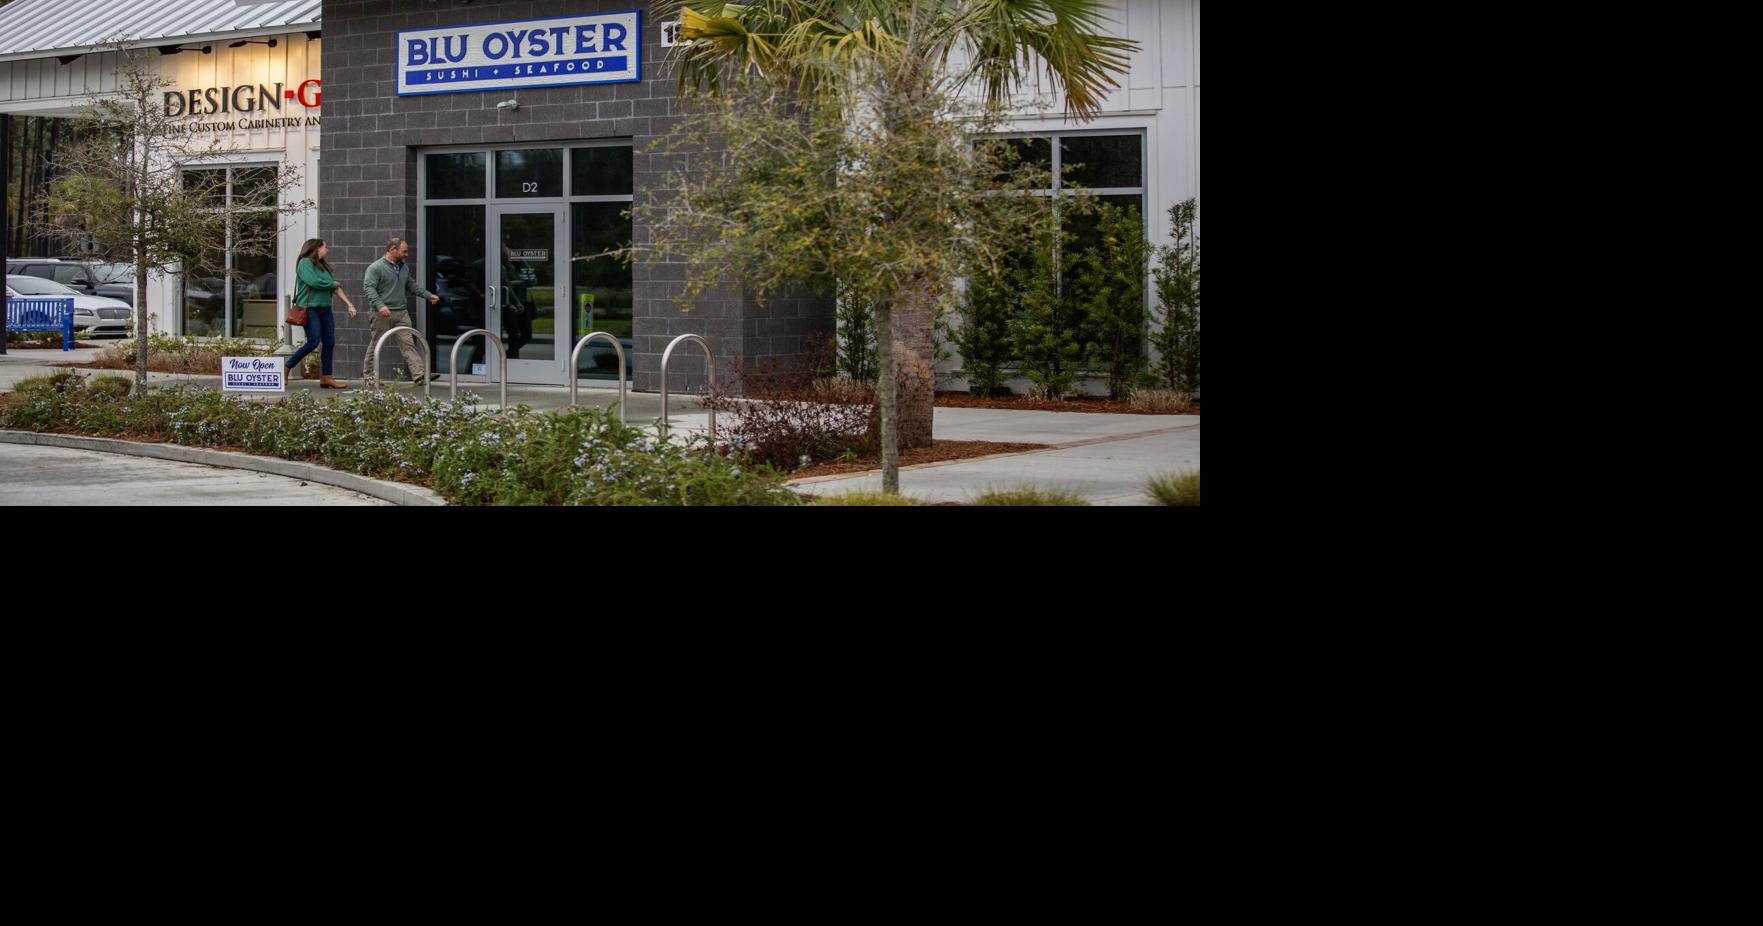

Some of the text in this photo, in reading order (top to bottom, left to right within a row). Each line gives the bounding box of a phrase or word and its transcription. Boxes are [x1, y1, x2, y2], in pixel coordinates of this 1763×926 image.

[406, 22, 627, 66] BLU OYSTER
[426, 69, 478, 81] SUSHI
[514, 61, 604, 75] SEAFOOD
[189, 121, 235, 133] CUSTOM
[238, 117, 301, 130] CABINETRY
[522, 182, 538, 193] D2
[229, 359, 275, 372] Now Open
[228, 374, 279, 382] BLU OYSTER
